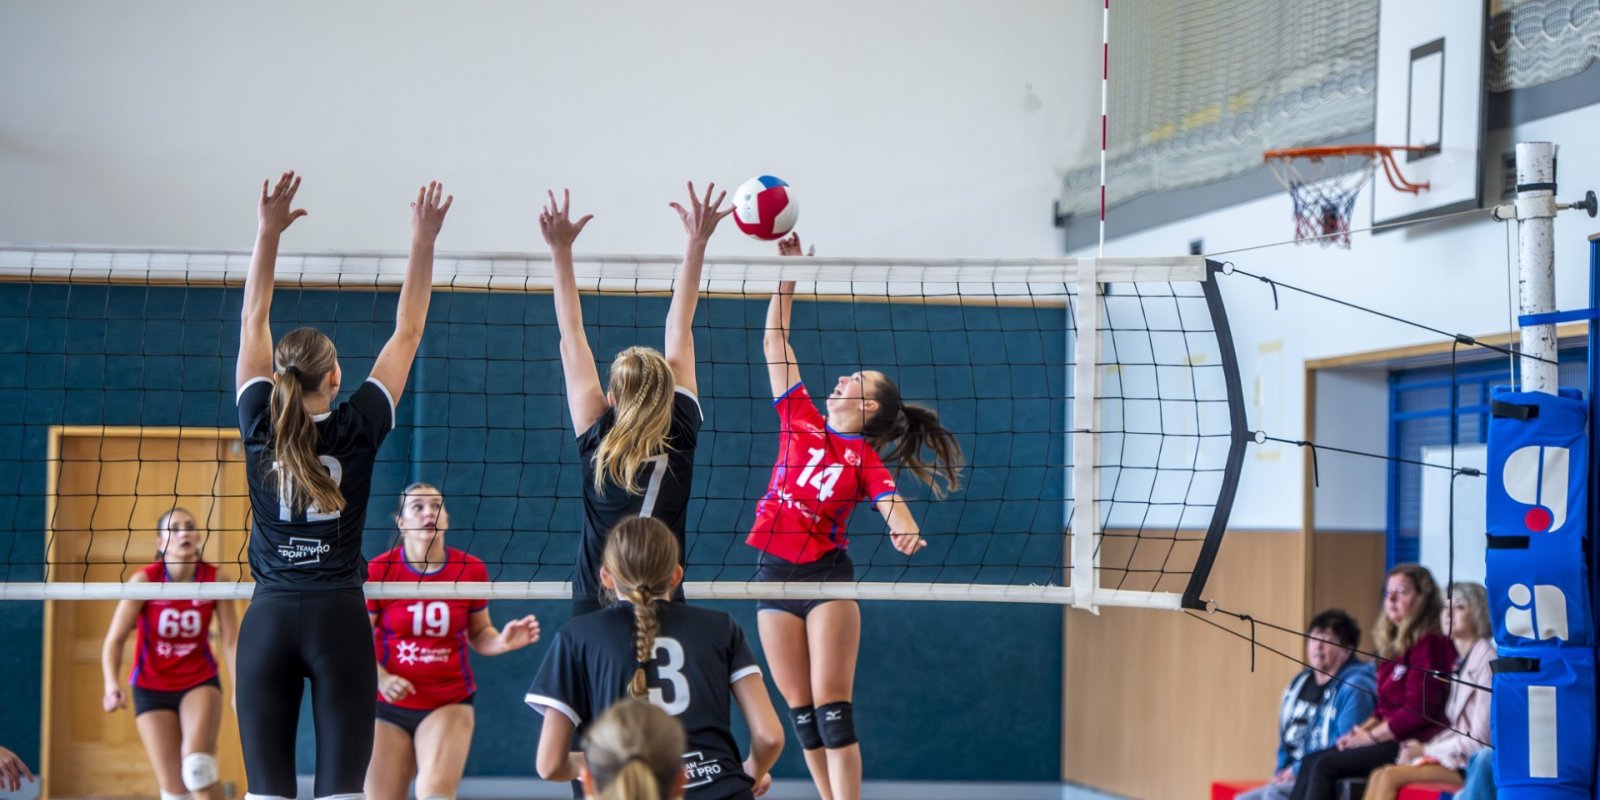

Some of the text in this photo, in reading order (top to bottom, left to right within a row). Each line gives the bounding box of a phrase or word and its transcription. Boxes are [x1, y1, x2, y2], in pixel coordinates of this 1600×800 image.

[639, 453, 669, 518] 7
[796, 447, 844, 502] 14
[310, 544, 330, 556] PRO
[158, 608, 202, 639] 69
[406, 601, 450, 637] 19
[648, 637, 690, 716] 3
[697, 764, 721, 777] PRO
